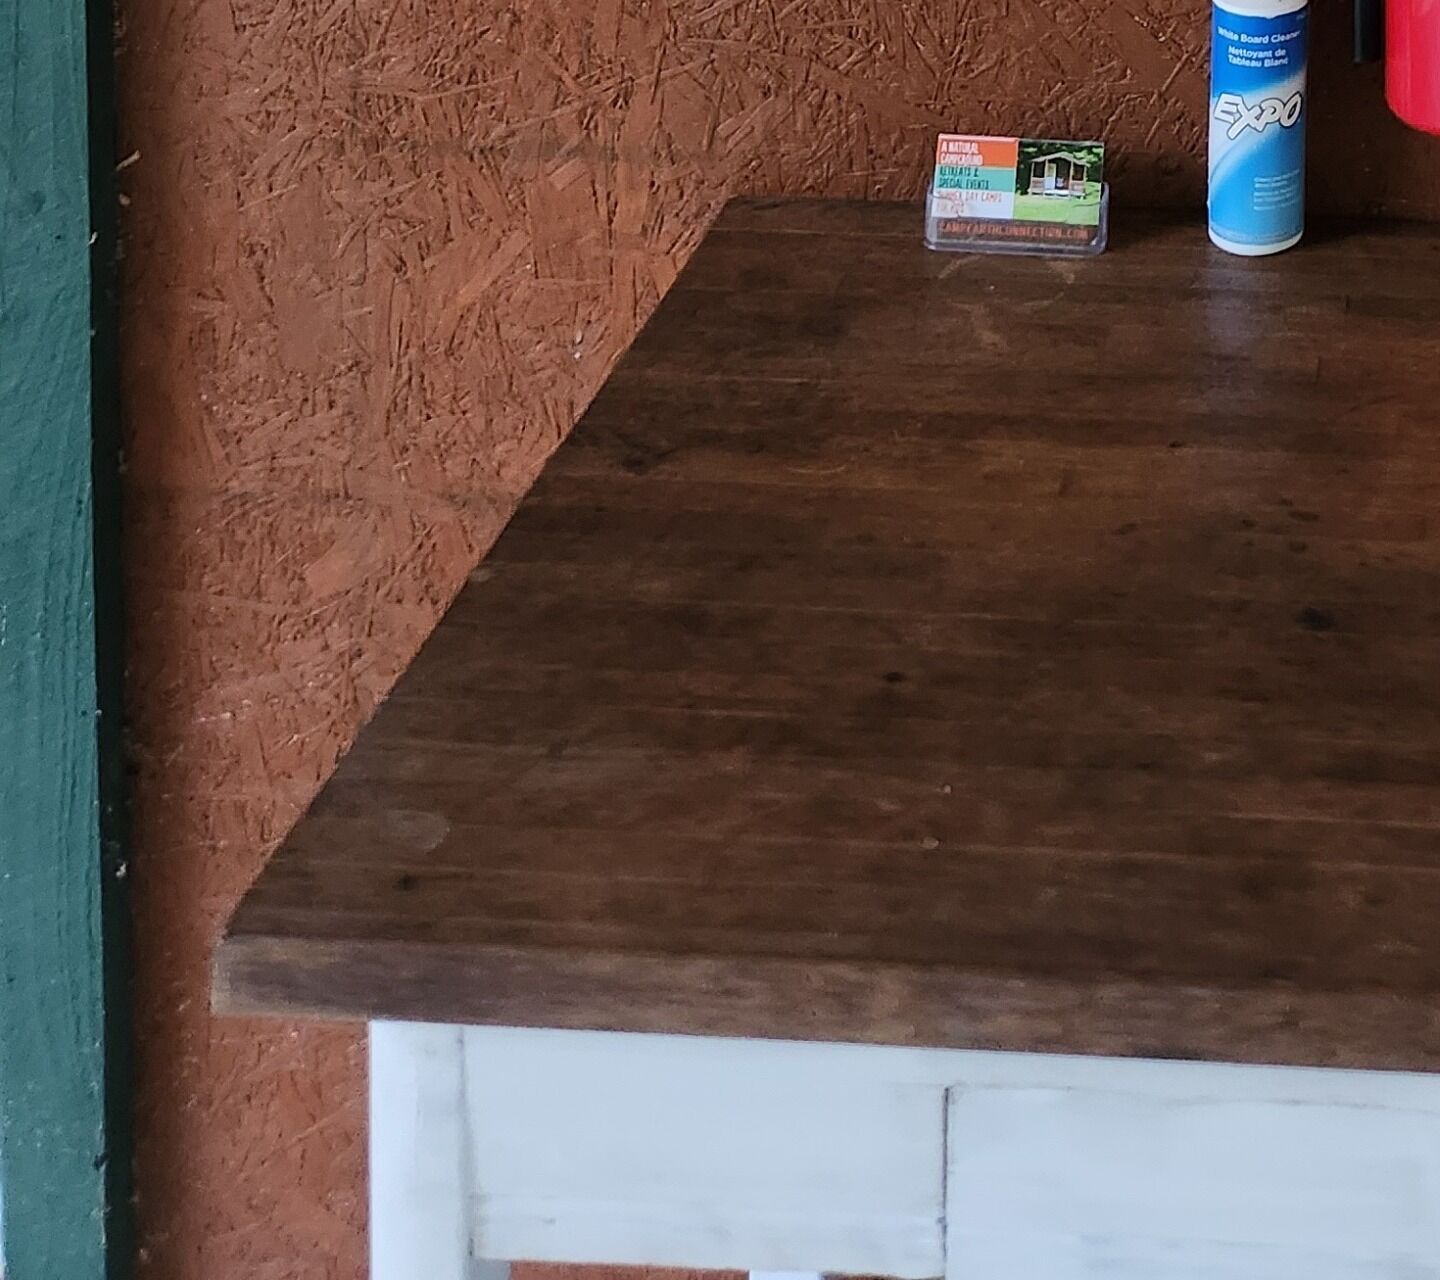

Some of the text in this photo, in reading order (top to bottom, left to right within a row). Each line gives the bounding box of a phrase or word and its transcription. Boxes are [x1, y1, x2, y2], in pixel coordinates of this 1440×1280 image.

[1241, 34, 1269, 43] Board
[1228, 45, 1272, 58] Nettoyant
[1228, 55, 1288, 67] Tableau Blanc
[1213, 93, 1302, 139] EXPO
